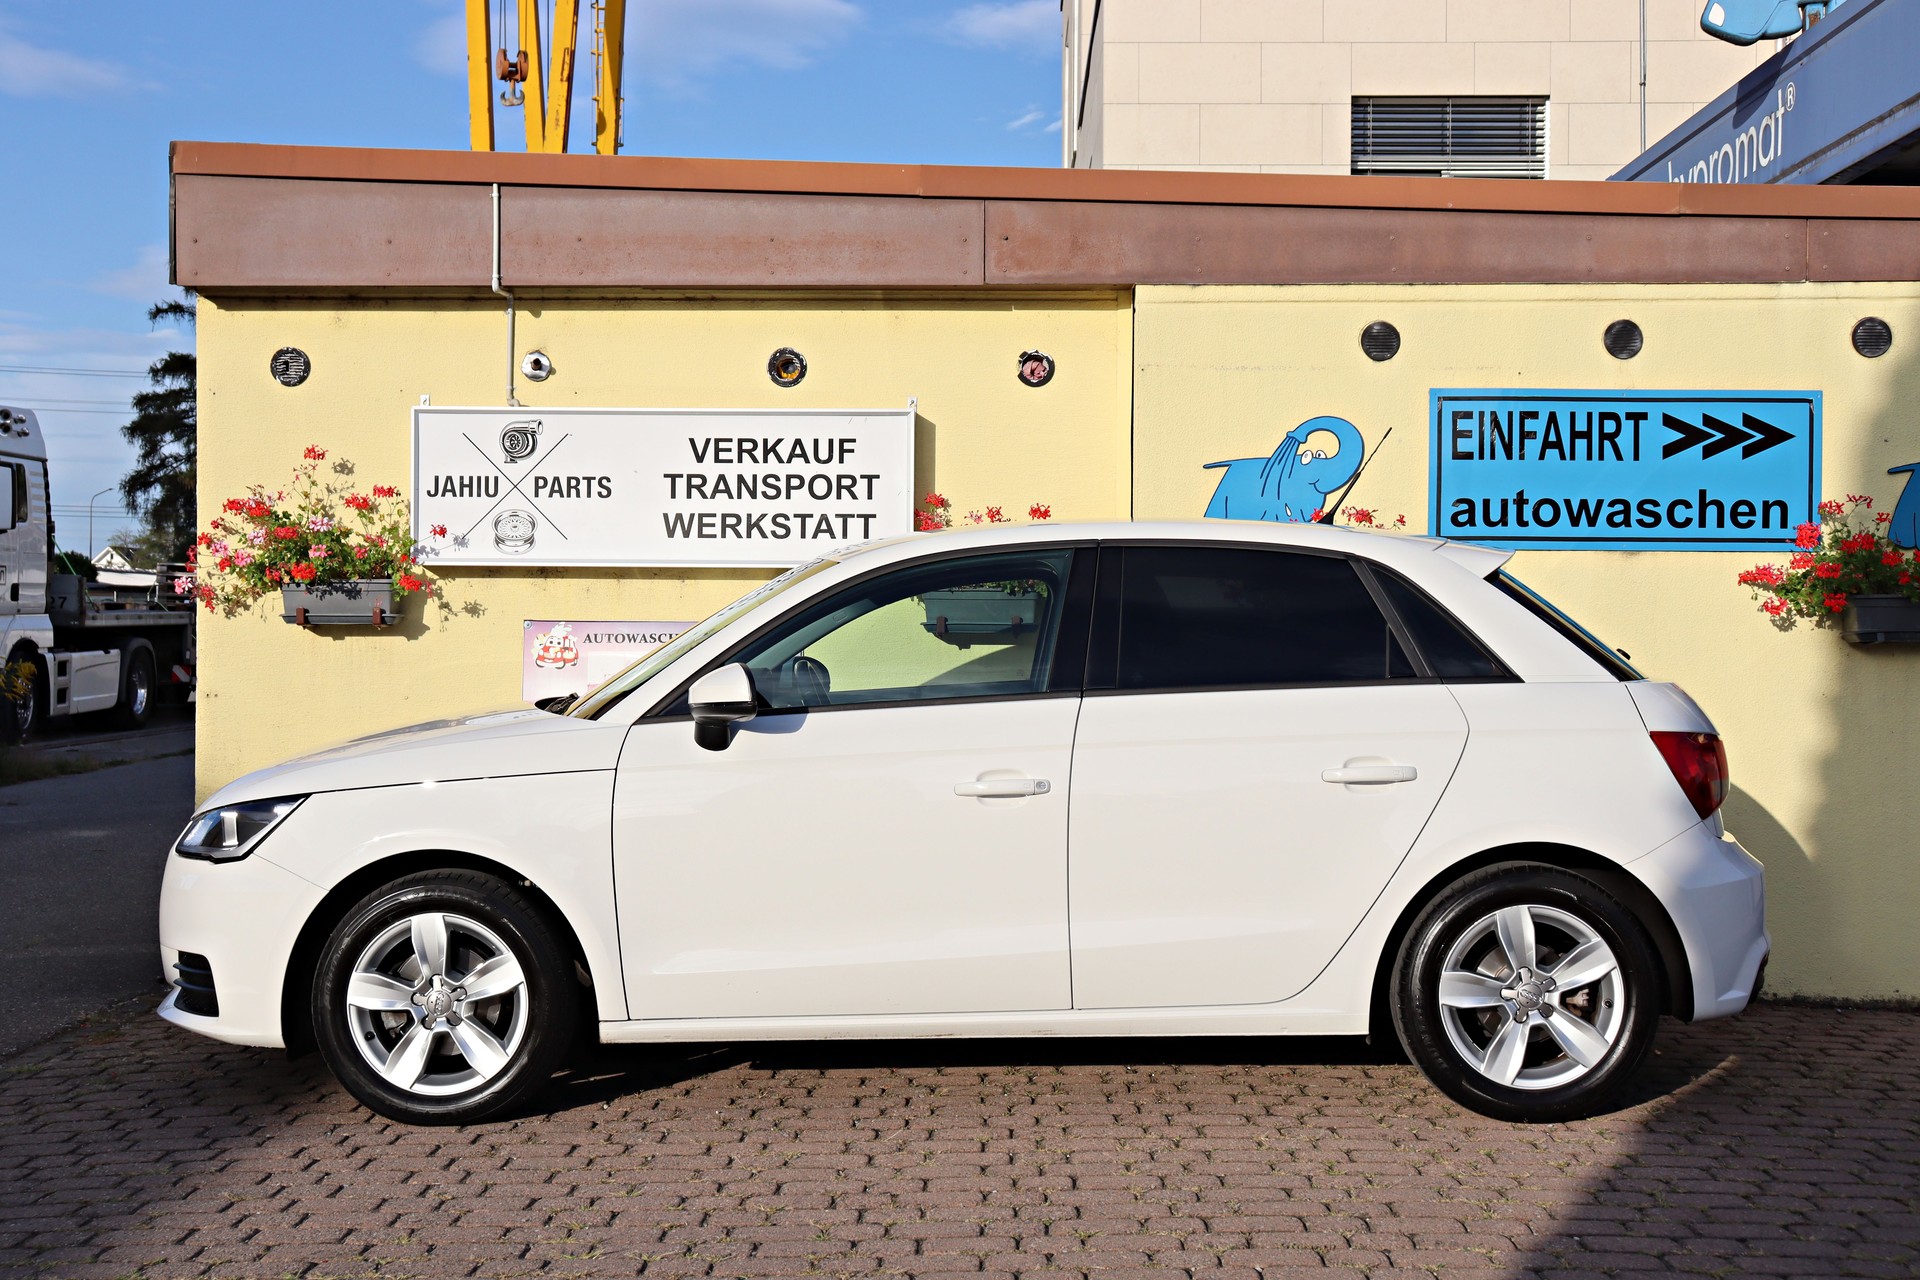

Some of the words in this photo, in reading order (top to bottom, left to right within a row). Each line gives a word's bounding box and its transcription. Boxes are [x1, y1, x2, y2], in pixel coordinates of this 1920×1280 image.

[1451, 410, 1649, 462] EINFAHRT
[688, 437, 857, 465] VERKAUF
[426, 475, 499, 498] JAHIU
[533, 475, 612, 499] PARTS
[663, 473, 881, 501] TRANSPORT
[1450, 488, 1789, 530] autowaschen
[662, 512, 877, 540] WERKSTATT
